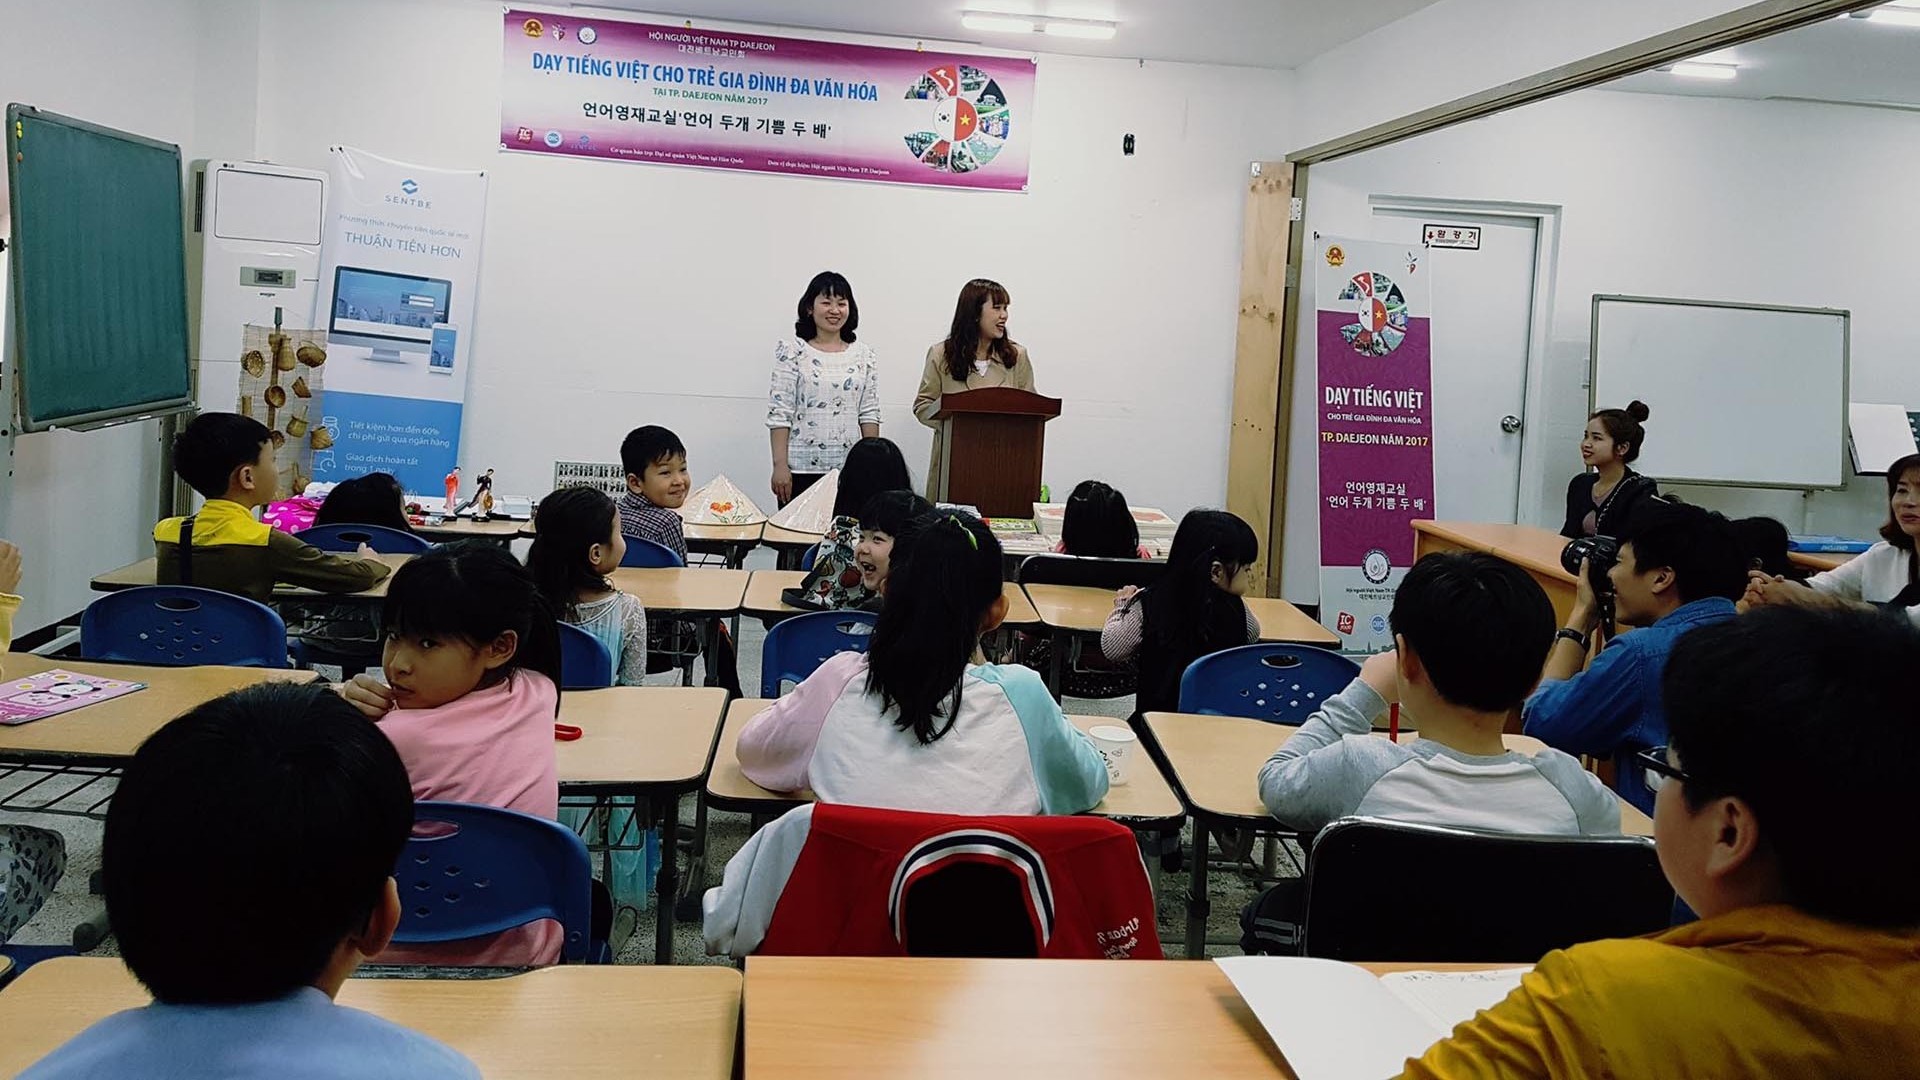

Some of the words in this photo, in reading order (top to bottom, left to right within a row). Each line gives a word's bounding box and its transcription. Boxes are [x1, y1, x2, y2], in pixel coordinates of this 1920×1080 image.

[649, 32, 664, 42] HỘI
[692, 35, 709, 45] VIỆT
[710, 37, 728, 46] NAM
[729, 39, 739, 48] TP
[740, 40, 776, 51] DAEJEON
[533, 52, 563, 75] DẠY
[566, 53, 612, 77] TIẾNG
[615, 60, 650, 84] VIỆT
[653, 65, 684, 84] CHO
[687, 65, 716, 86] TRẺ
[719, 71, 745, 89] GIA
[748, 72, 786, 93] ĐÌNH
[790, 78, 810, 96] ĐA
[814, 78, 845, 98] VĂN
[848, 81, 878, 101] HÓA
[653, 87, 668, 98] TẠI
[669, 88, 682, 97] TP.
[682, 89, 723, 101] DAEJEON
[724, 91, 746, 104] NĂM
[747, 95, 768, 106] 2017
[719, 115, 750, 133] 두개
[756, 118, 786, 136] 기쁨
[792, 121, 807, 138] 두
[385, 194, 432, 210] SENTBE
[344, 231, 393, 251] THUẬN
[396, 238, 427, 254] TIỆN
[430, 246, 461, 259] HƠN
[1325, 386, 1350, 410] DẠY
[1352, 384, 1392, 408] TIẾNG
[1394, 388, 1423, 413] VIỆT
[1327, 412, 1341, 421] CHO
[1353, 414, 1365, 422] GIA
[1365, 413, 1382, 423] ĐÌNH
[1383, 415, 1393, 423] ĐA
[1321, 431, 1335, 442] TP.
[1336, 432, 1379, 444] DAEJEON
[1381, 434, 1404, 446] NĂM
[1405, 436, 1428, 447] 2017
[345, 453, 364, 462] Giao
[1345, 481, 1406, 496] 언어영재교실
[1352, 497, 1372, 509] 두개
[1400, 498, 1410, 510] 두
[1340, 615, 1351, 625] IC
